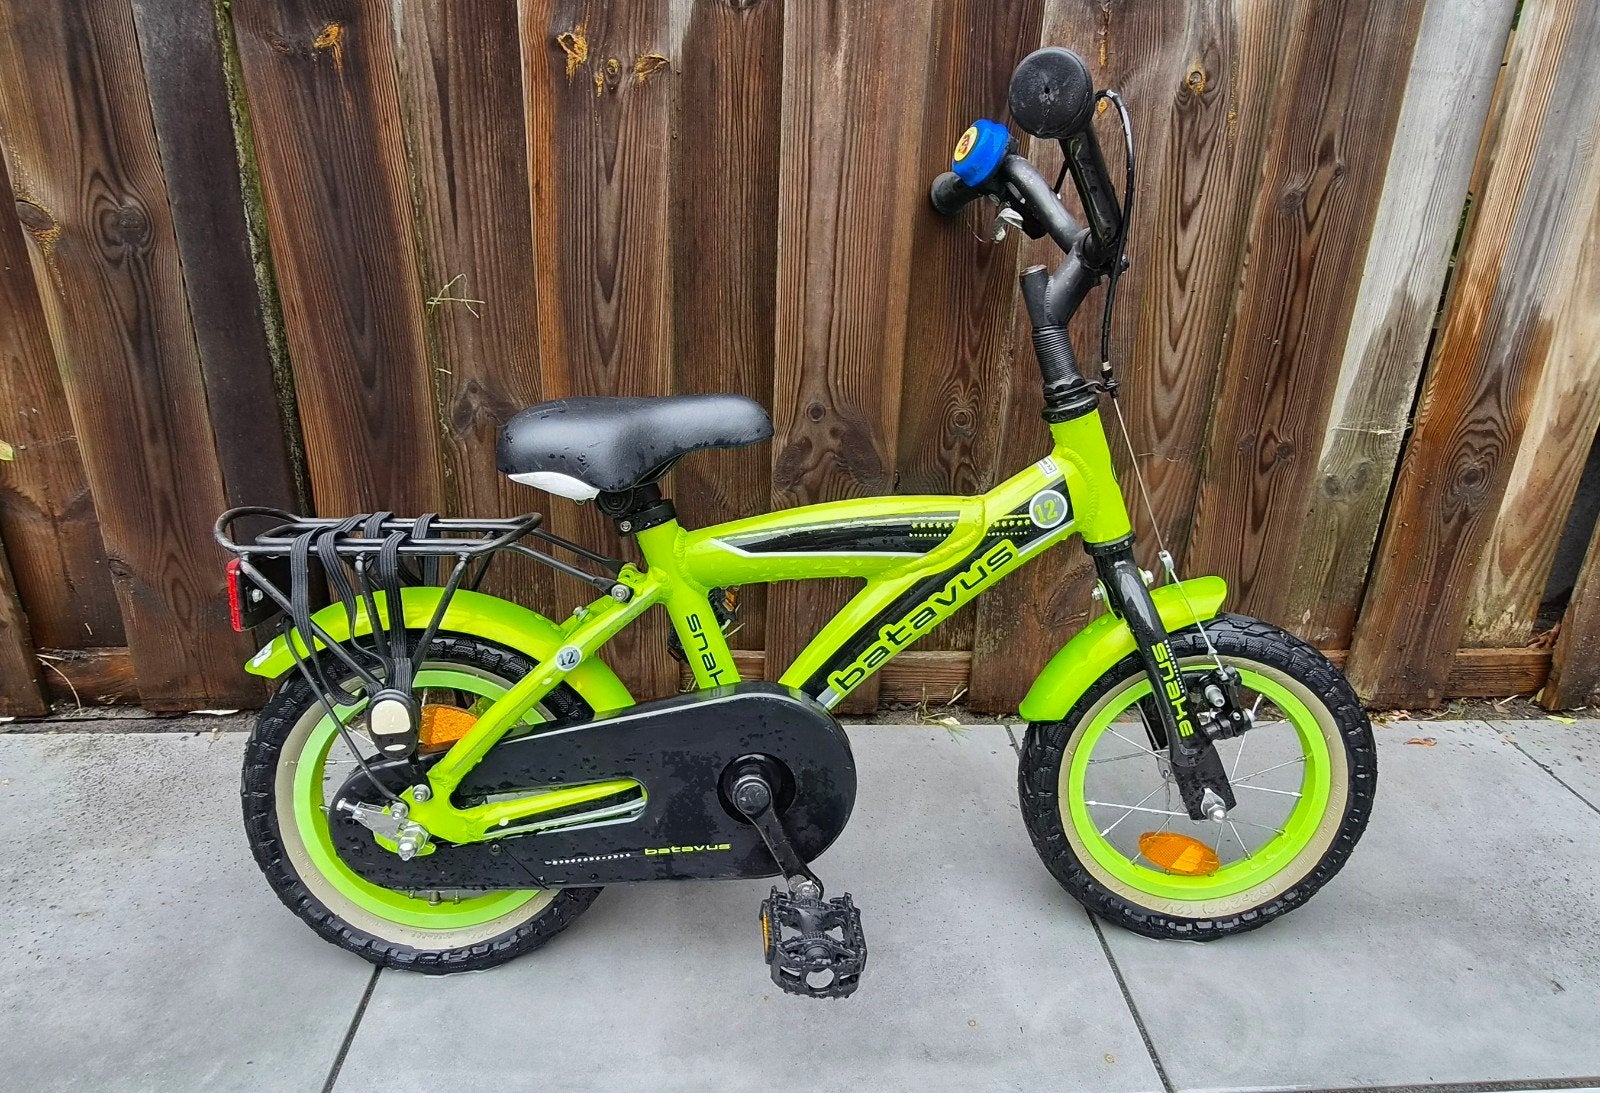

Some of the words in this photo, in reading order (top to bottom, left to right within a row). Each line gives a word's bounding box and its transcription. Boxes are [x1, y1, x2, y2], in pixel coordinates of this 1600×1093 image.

[833, 543, 1014, 692] batavus
[1151, 642, 1195, 737] snake
[644, 843, 732, 856] batavus
